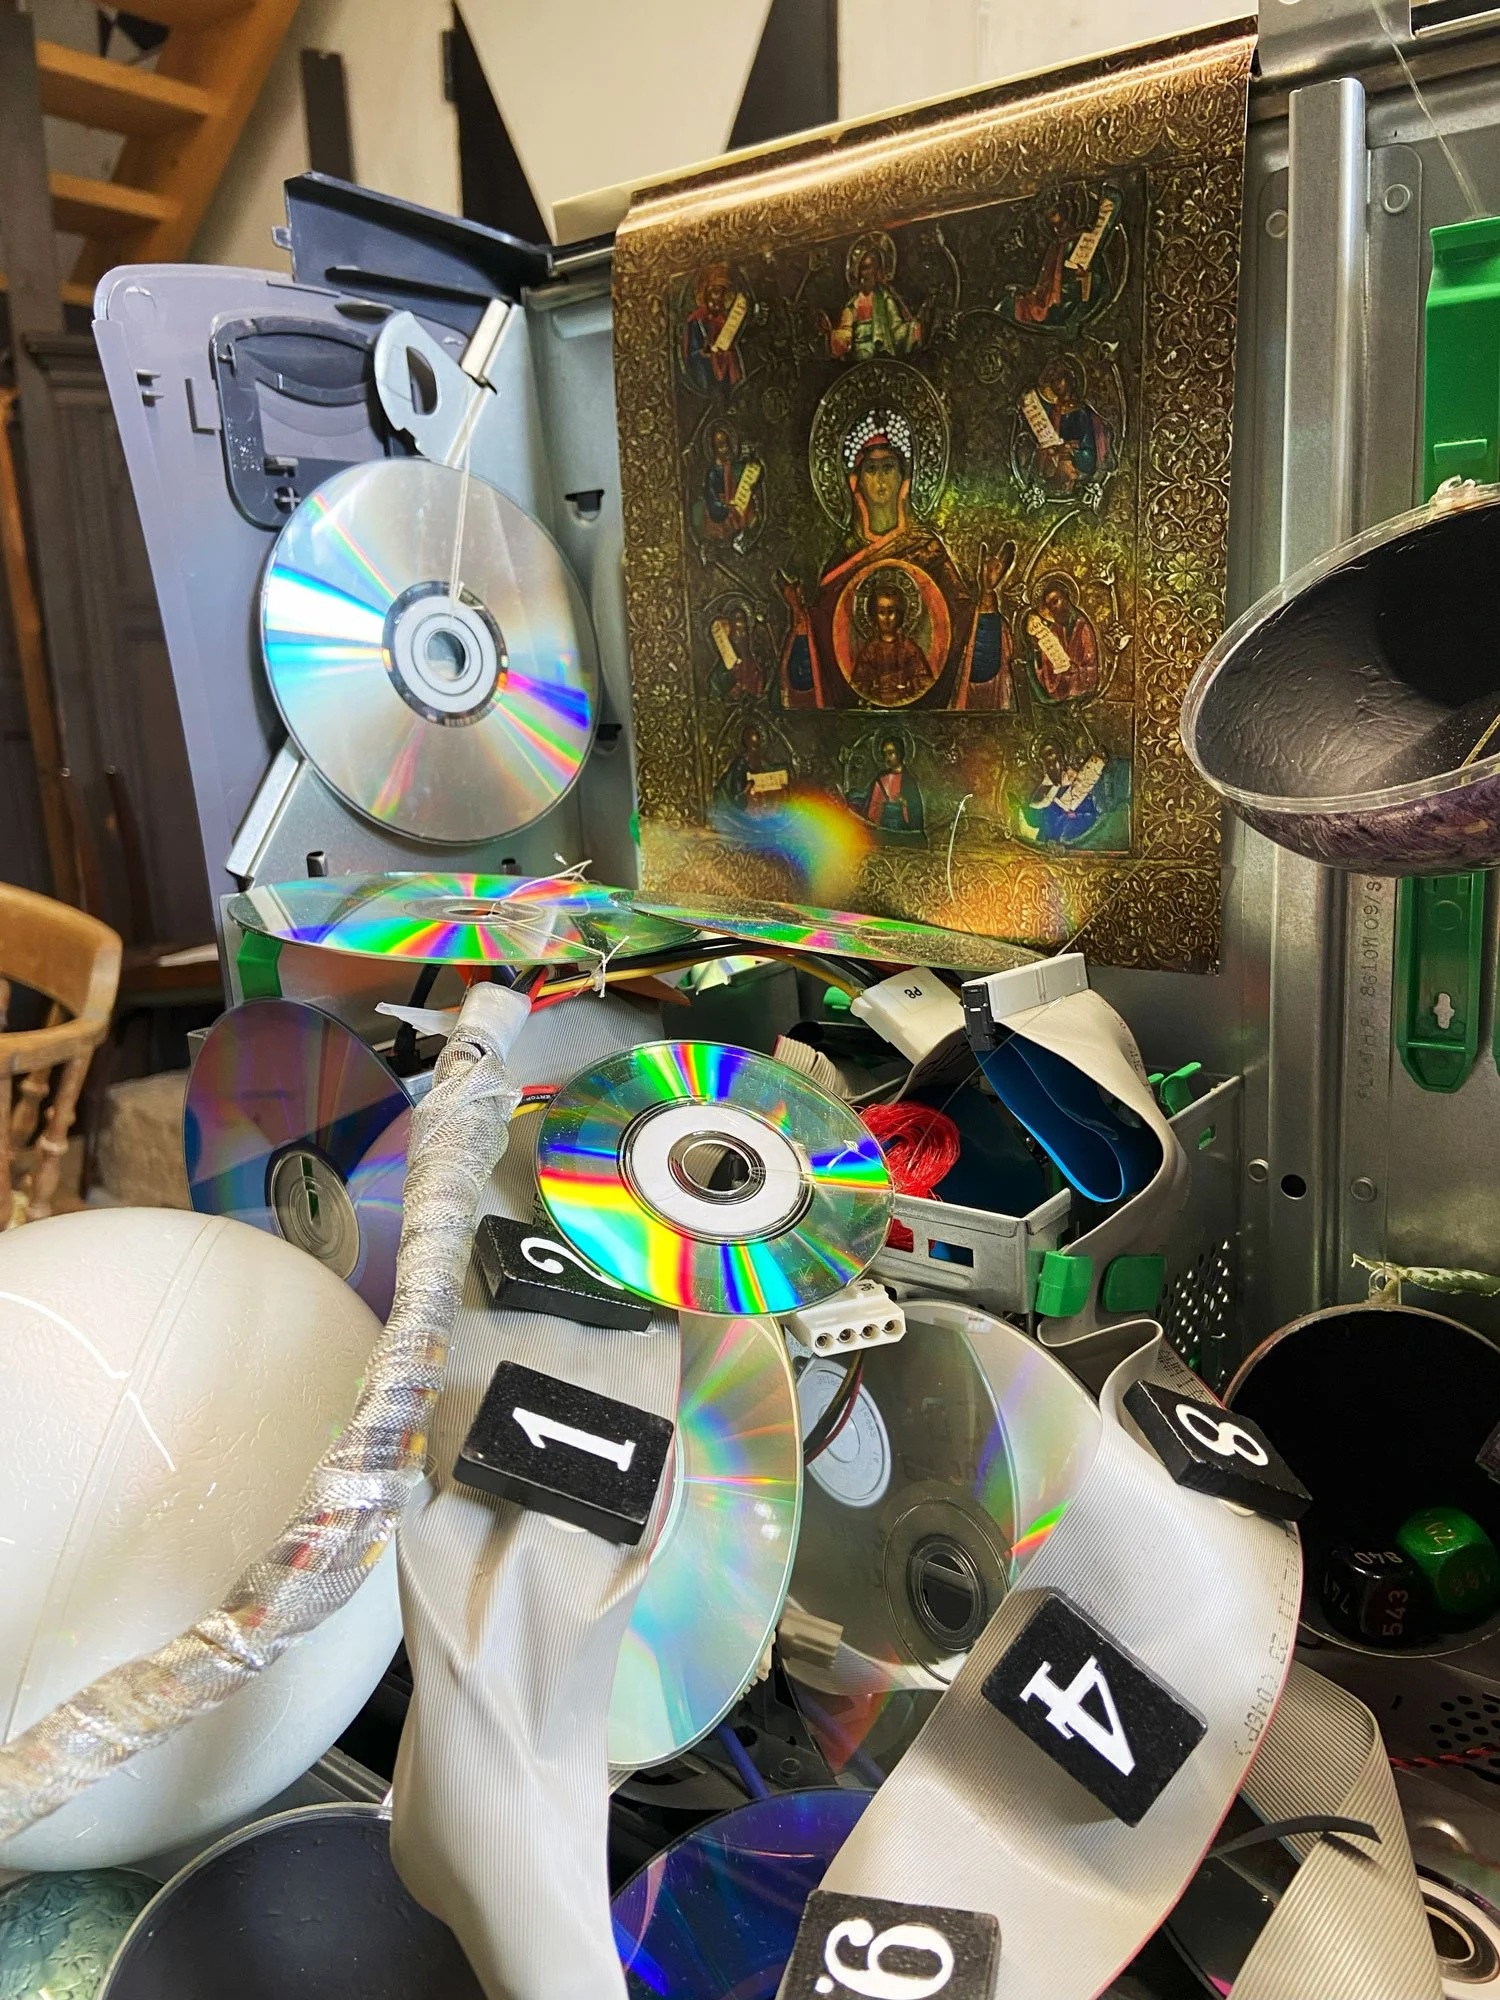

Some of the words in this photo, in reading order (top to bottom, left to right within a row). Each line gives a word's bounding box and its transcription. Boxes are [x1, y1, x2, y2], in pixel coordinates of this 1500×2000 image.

[512, 1406, 637, 1472] 1
[1176, 1404, 1270, 1466] 8
[1382, 1590, 1409, 1637] 543
[1019, 1655, 1136, 1776] 4
